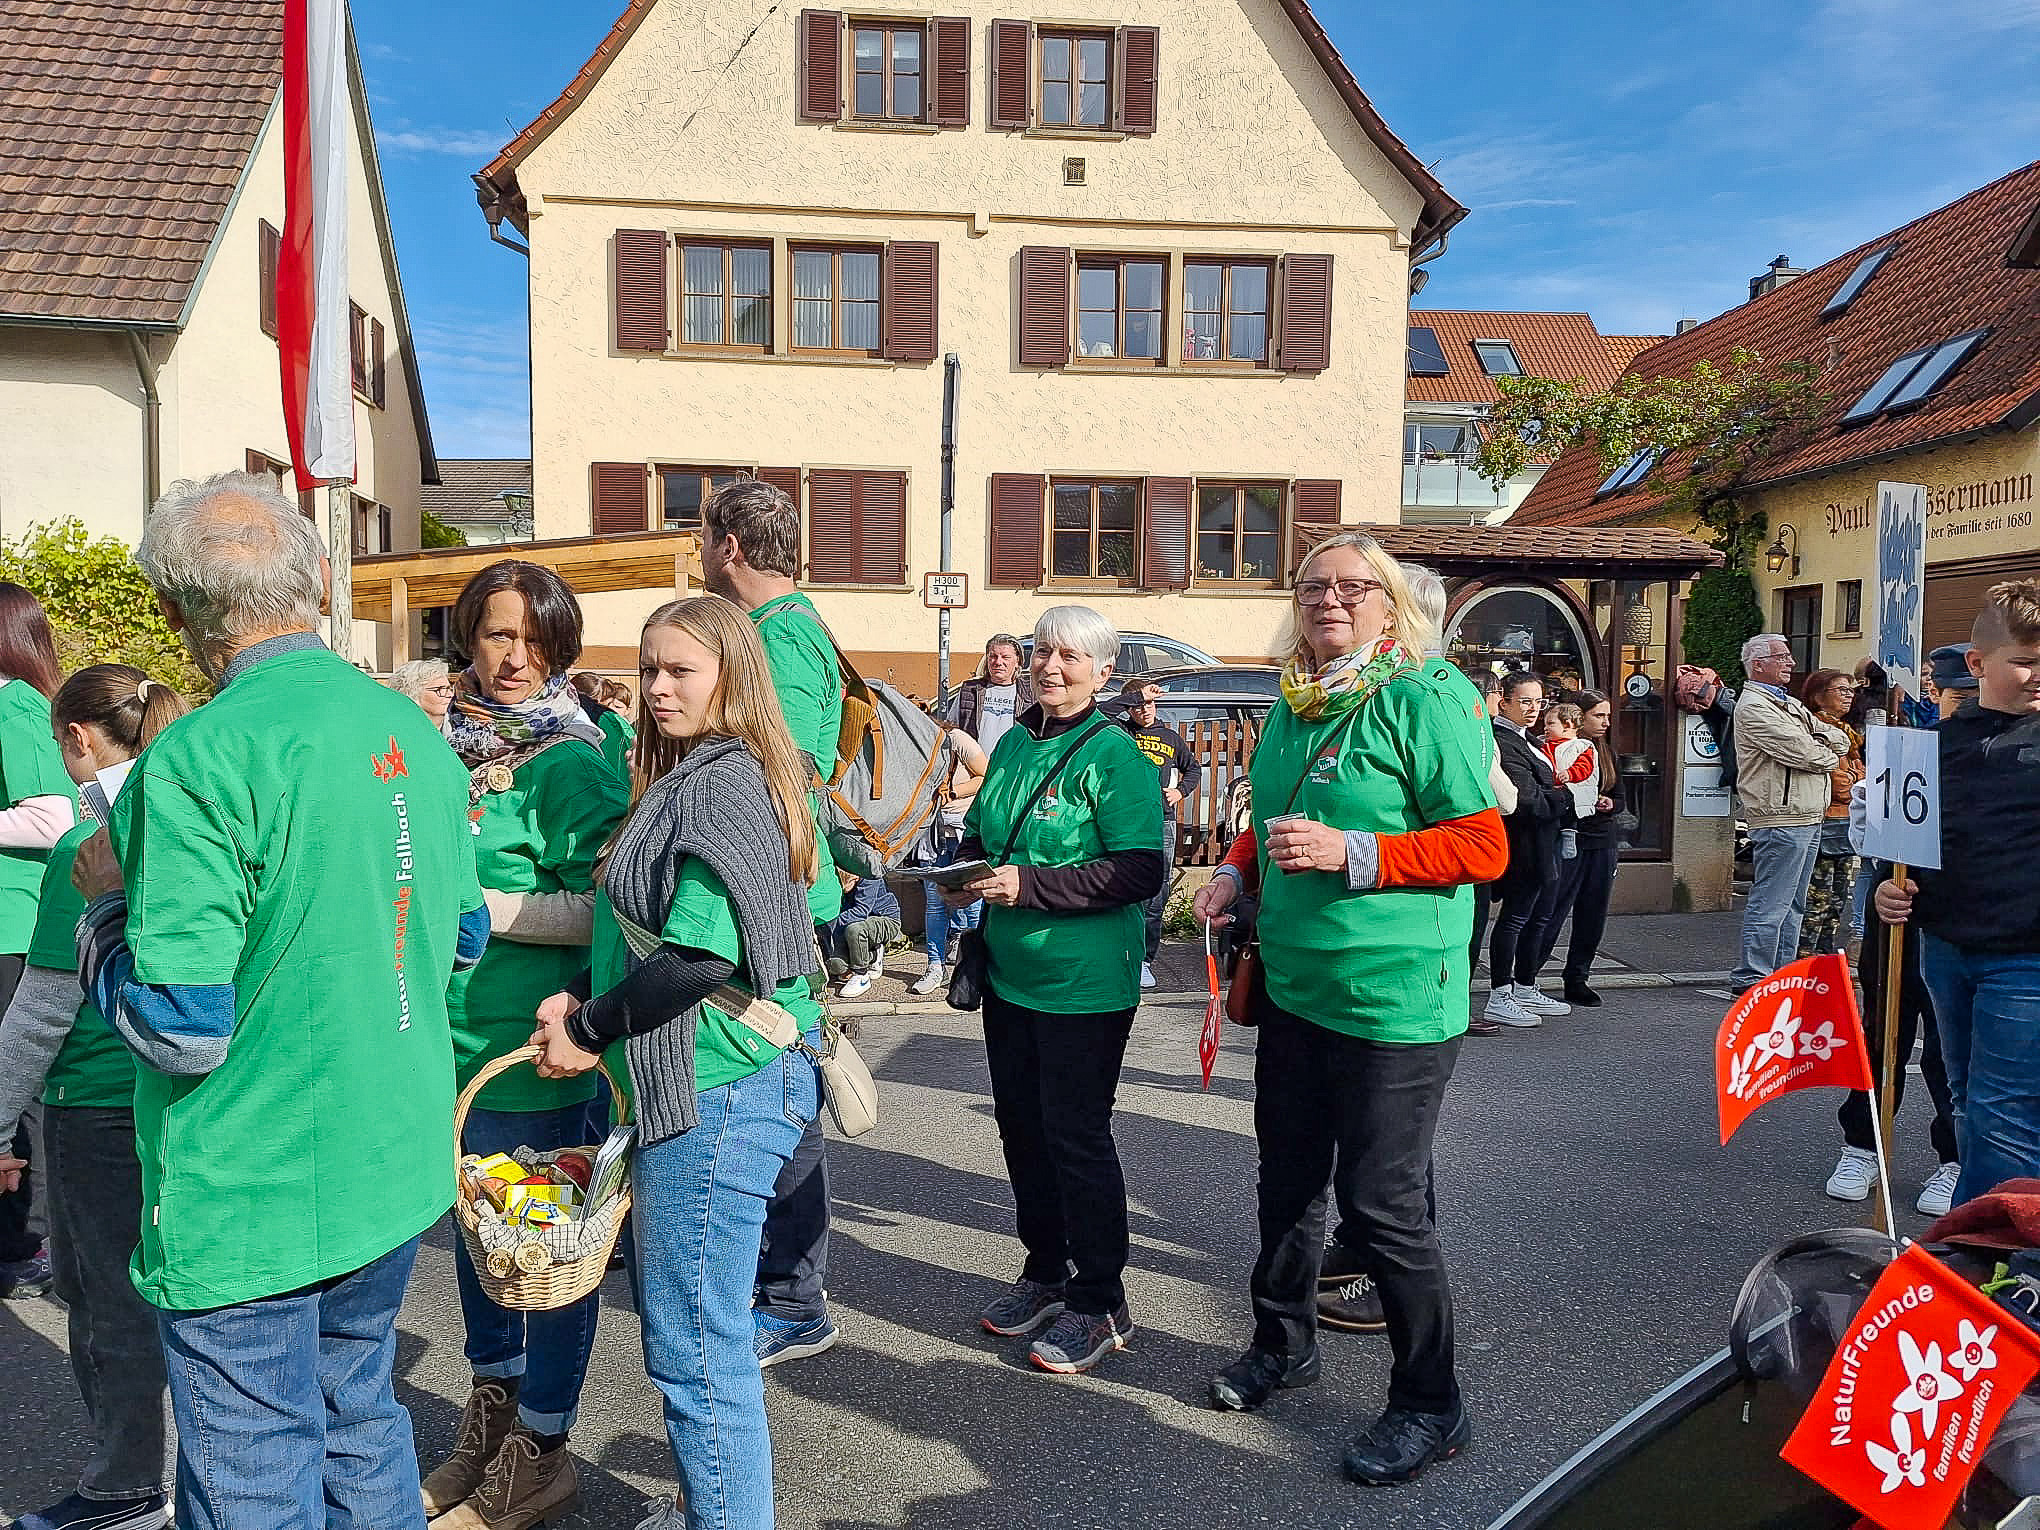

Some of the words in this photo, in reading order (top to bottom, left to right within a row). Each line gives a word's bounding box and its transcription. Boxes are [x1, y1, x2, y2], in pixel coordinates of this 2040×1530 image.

[1824, 495, 1871, 539] Paul
[1926, 472, 2034, 518] ssermann
[1984, 516, 2002, 531] seit
[2006, 511, 2032, 529] 1680
[934, 576, 958, 585] H300
[1136, 739, 1174, 759] ESDEN
[1875, 767, 1929, 825] 16
[391, 792, 413, 882] Fellbach
[1725, 976, 1830, 1049] NaturFreunde
[1758, 1061, 1814, 1100] freundlich
[1830, 1284, 1935, 1447] NaturFreunde
[1933, 1411, 1963, 1482] familien
[1957, 1379, 1995, 1465] freundlich
